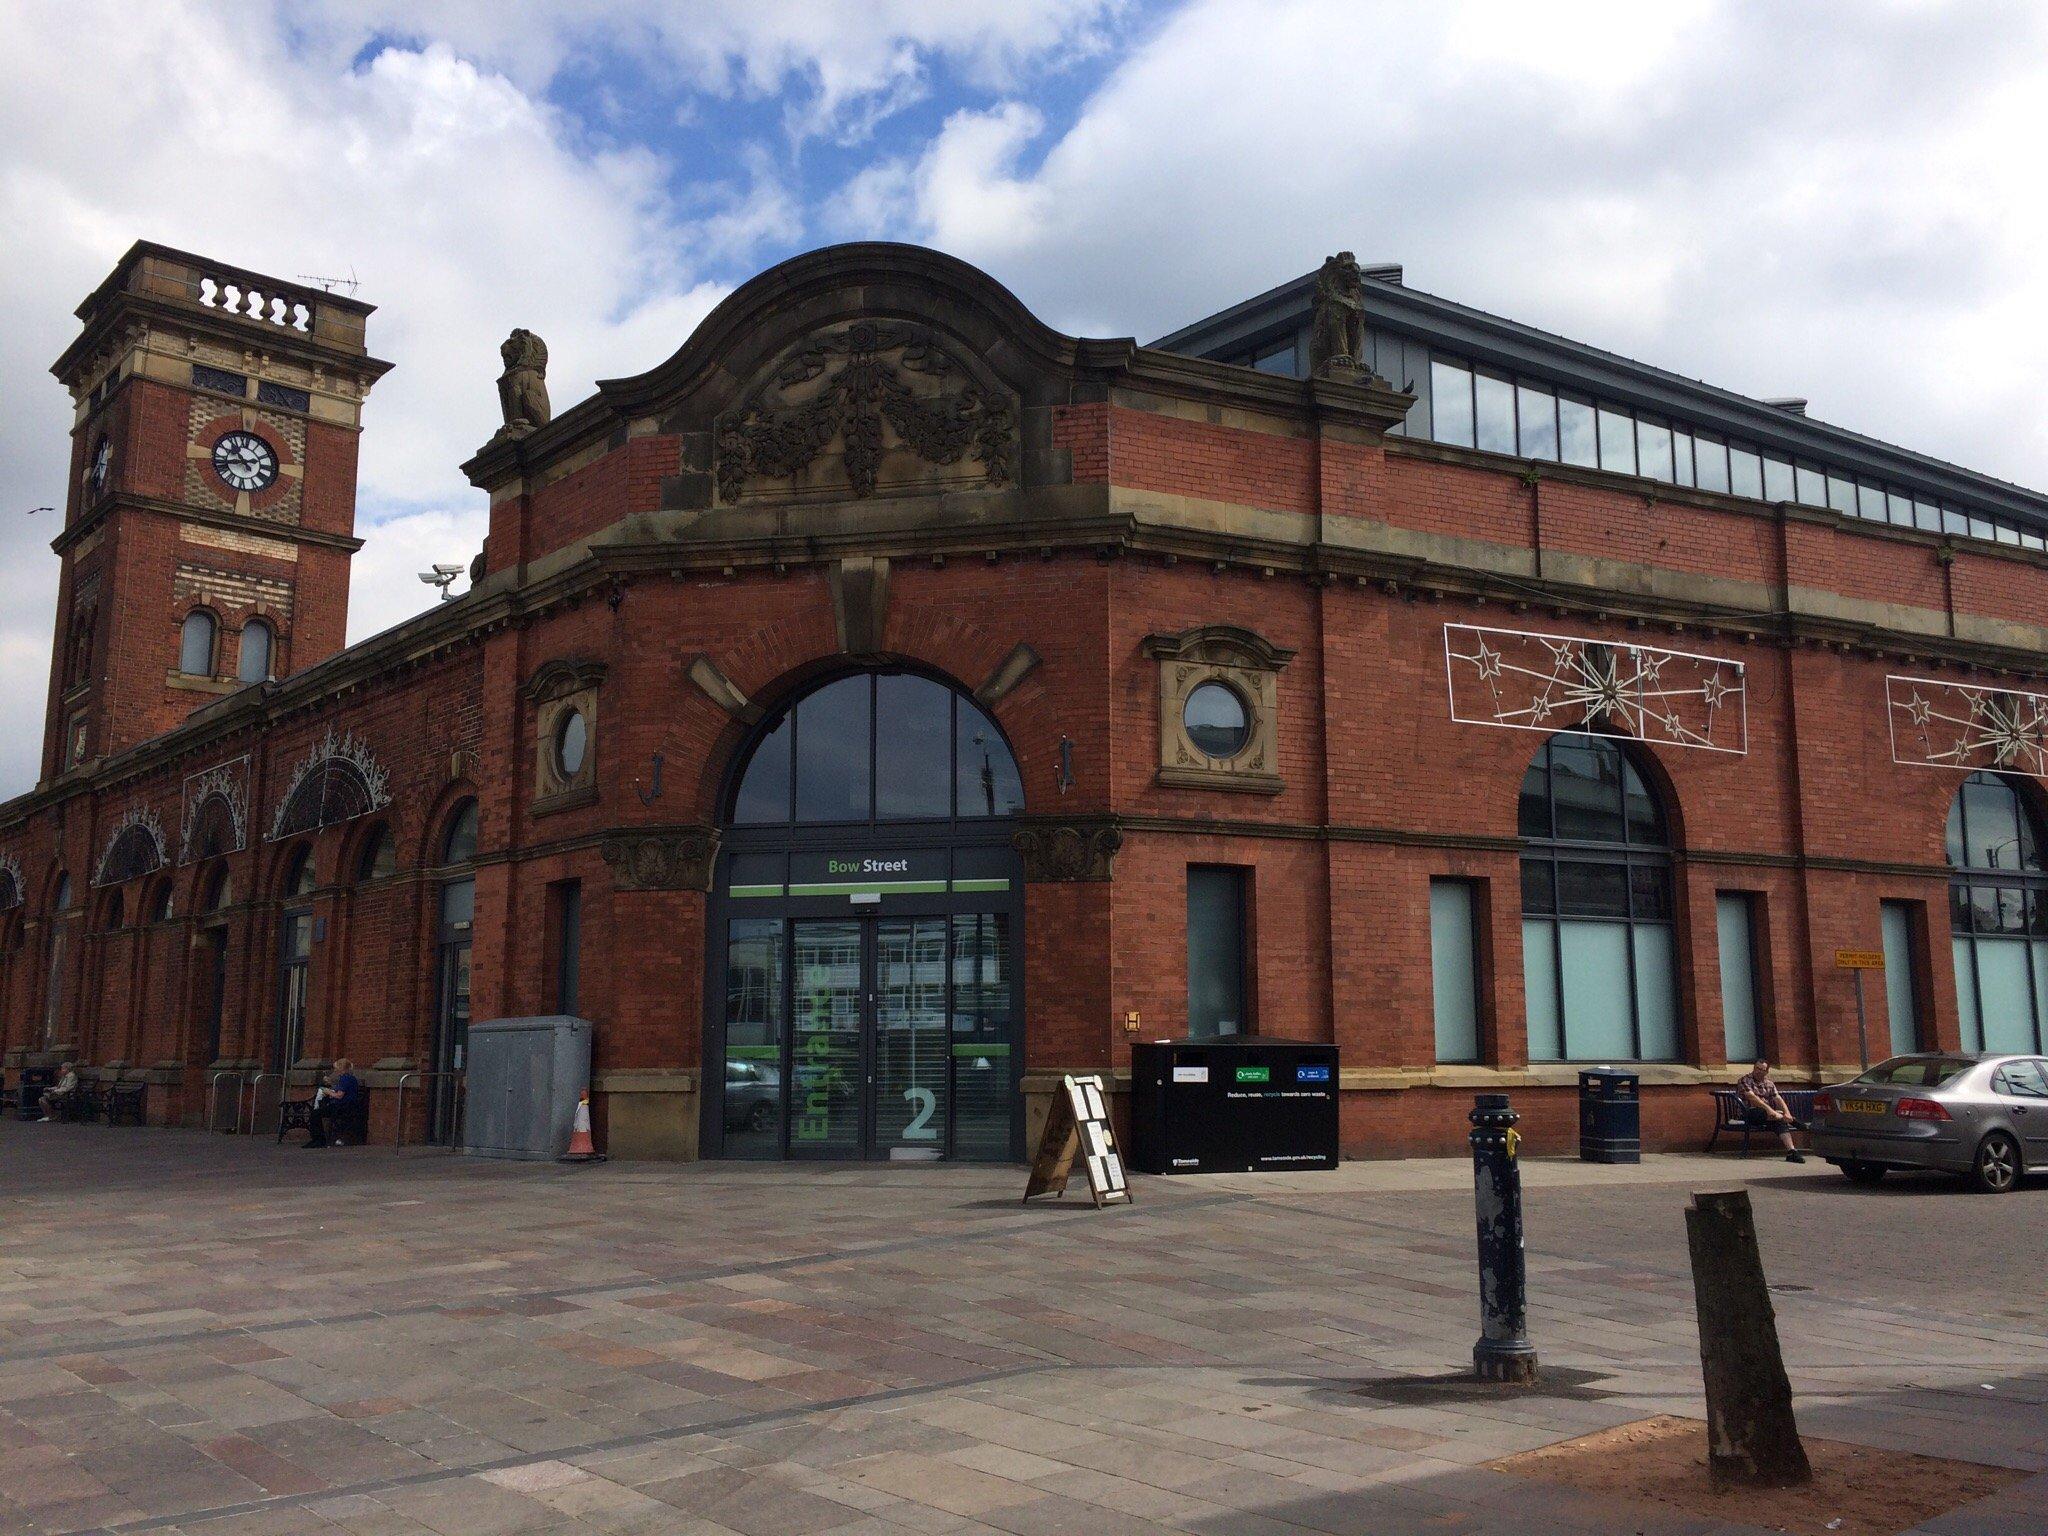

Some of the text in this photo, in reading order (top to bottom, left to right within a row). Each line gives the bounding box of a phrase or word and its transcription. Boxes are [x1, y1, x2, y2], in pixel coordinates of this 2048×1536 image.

[828, 859, 908, 873] Bow Street
[799, 965, 830, 1140] Entrance
[902, 1087, 938, 1139] 2
